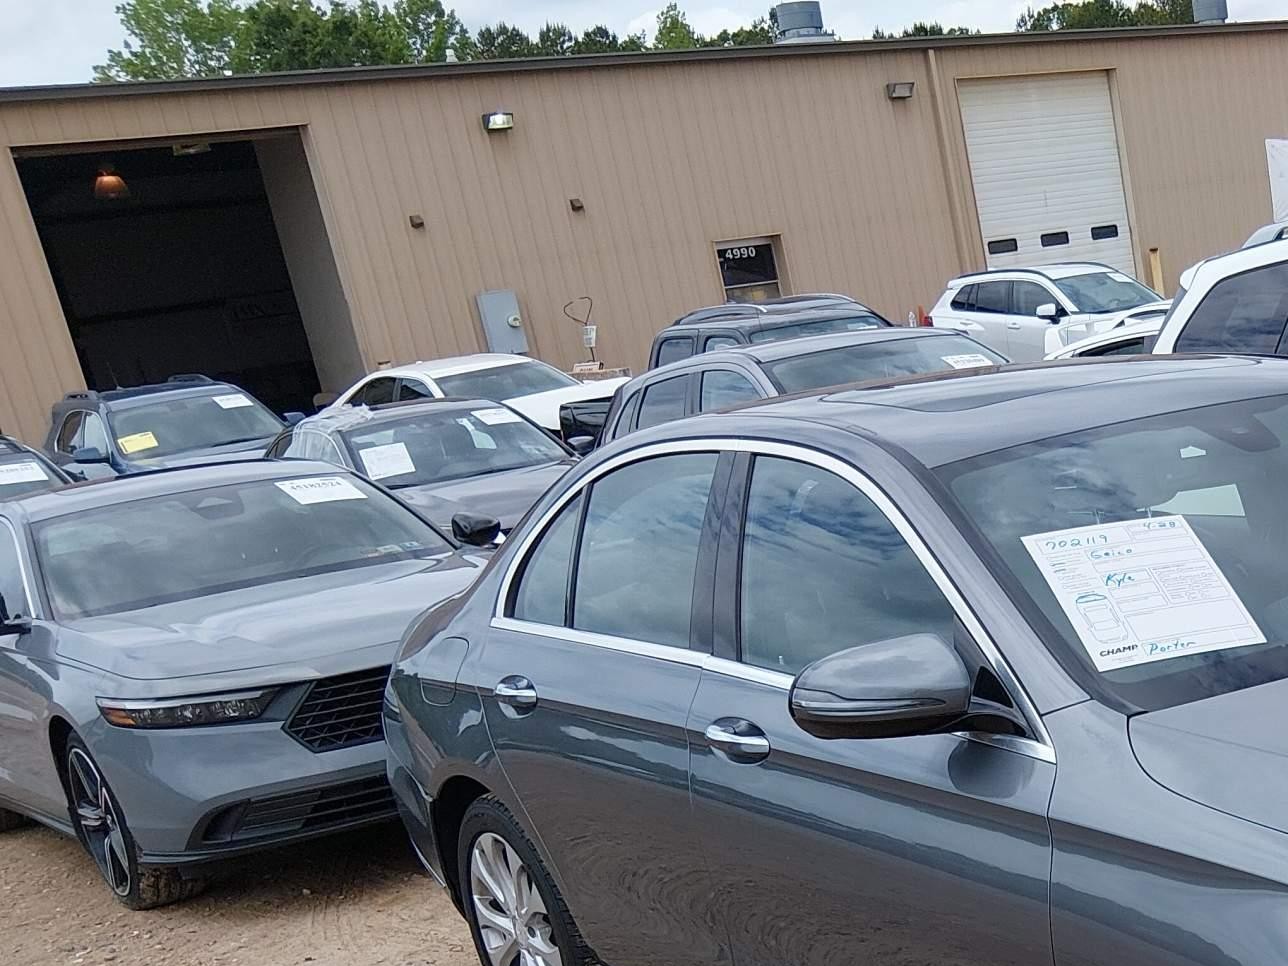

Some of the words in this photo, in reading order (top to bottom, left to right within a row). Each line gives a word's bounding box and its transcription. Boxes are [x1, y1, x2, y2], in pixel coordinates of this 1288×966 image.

[725, 247, 756, 260] 4990
[1105, 572, 1135, 587] Kyle
[1099, 644, 1139, 657] CHAMP
[1147, 640, 1197, 656] Porter
